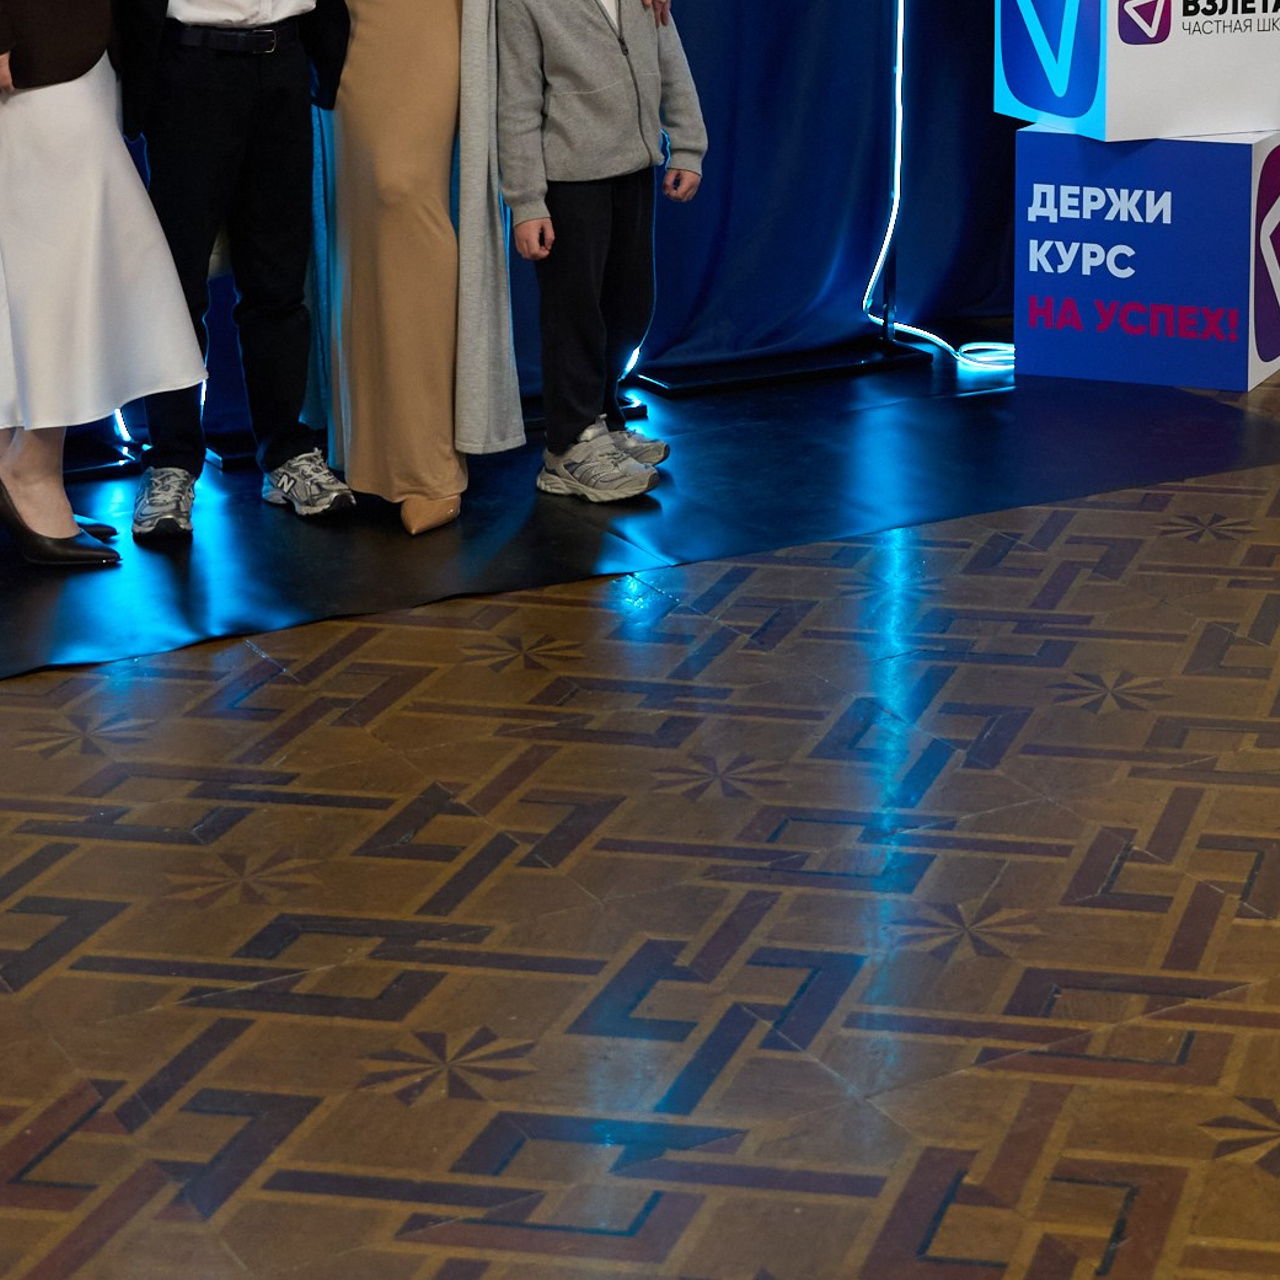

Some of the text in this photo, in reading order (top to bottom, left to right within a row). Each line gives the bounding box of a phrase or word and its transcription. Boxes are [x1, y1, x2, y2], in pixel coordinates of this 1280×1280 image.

[1182, 18, 1253, 36] ЧАСТНАЯ
[1027, 183, 1172, 225] ДЕРЖИ
[1028, 239, 1136, 279] КУРС
[1027, 295, 1239, 343] НА УСПЕХ!
[277, 474, 295, 494] N
